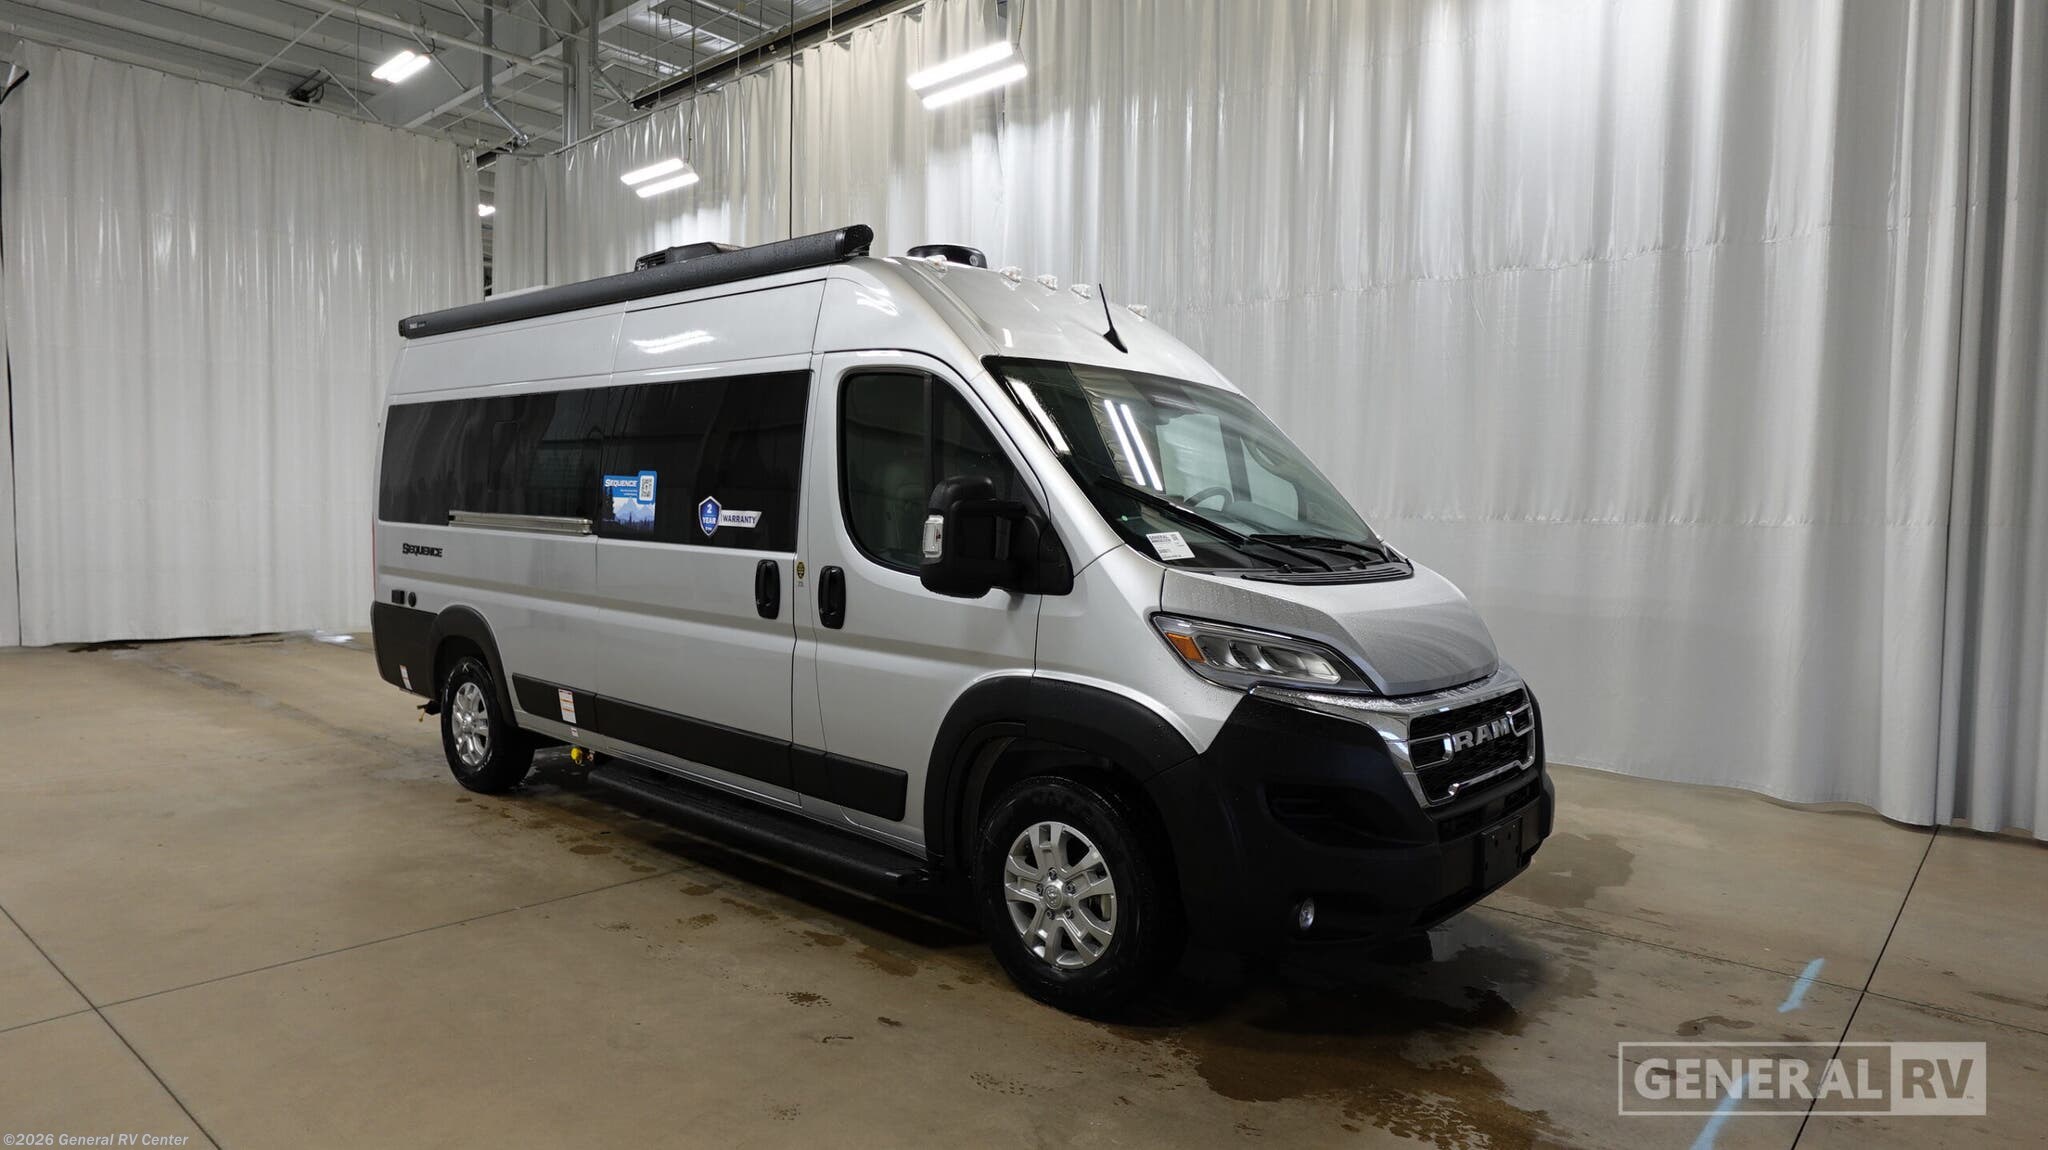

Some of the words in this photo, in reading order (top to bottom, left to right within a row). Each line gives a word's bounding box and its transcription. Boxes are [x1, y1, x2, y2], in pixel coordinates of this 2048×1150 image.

[604, 479, 638, 487] SEQUENCE
[706, 503, 713, 514] 2
[702, 516, 717, 525] YEAR
[722, 514, 757, 524] WARRANTY
[402, 542, 443, 558] SEQUENCE
[1452, 717, 1511, 752] RAM
